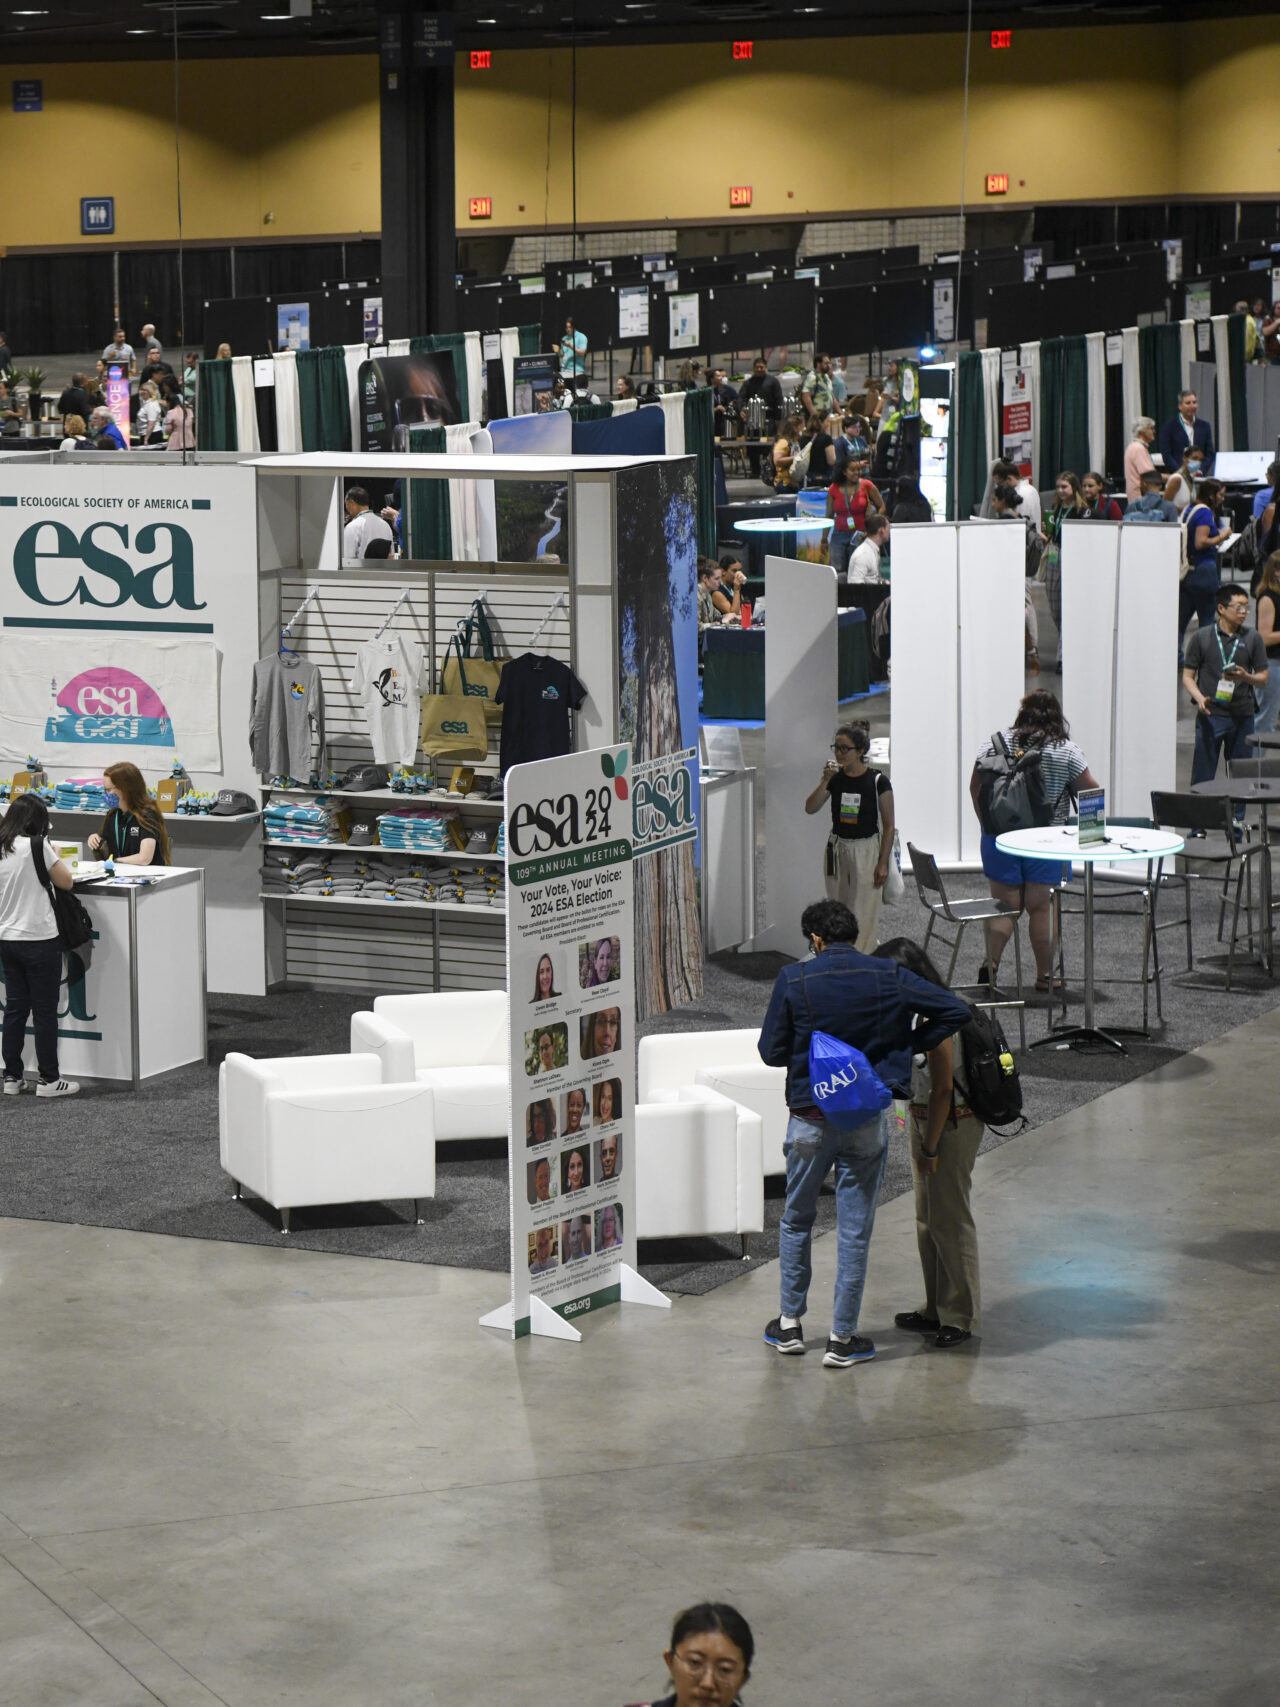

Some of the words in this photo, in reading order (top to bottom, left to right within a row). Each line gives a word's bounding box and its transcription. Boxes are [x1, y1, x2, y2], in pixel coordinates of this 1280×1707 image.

[733, 42, 753, 59] EXIT
[992, 30, 1011, 48] EXIT
[470, 51, 491, 68] EXIT
[731, 187, 752, 204] EXIT
[988, 175, 1008, 192] EXIT
[470, 198, 492, 216] EXIT
[20, 496, 80, 508] ECOLOGICAL
[84, 498, 123, 508] SOCIETY
[128, 498, 140, 509] OF
[144, 499, 189, 510] AMERICA
[13, 520, 208, 610] esa
[78, 686, 142, 716] esa
[440, 720, 469, 734] esa
[585, 786, 612, 817] 20
[632, 766, 696, 840] esa
[508, 793, 583, 857] esa
[585, 812, 612, 842] 24
[539, 856, 578, 874] ANNUAL
[584, 844, 626, 864] MEETING
[520, 888, 542, 903] Your
[545, 884, 569, 897] Vote,
[571, 876, 592, 891] Your
[595, 870, 622, 883] Voice:
[531, 901, 554, 918] 2024
[556, 898, 574, 912] ESA
[576, 888, 613, 906] Election
[814, 1062, 858, 1100] ORAU
[564, 1297, 591, 1314] esa.org
